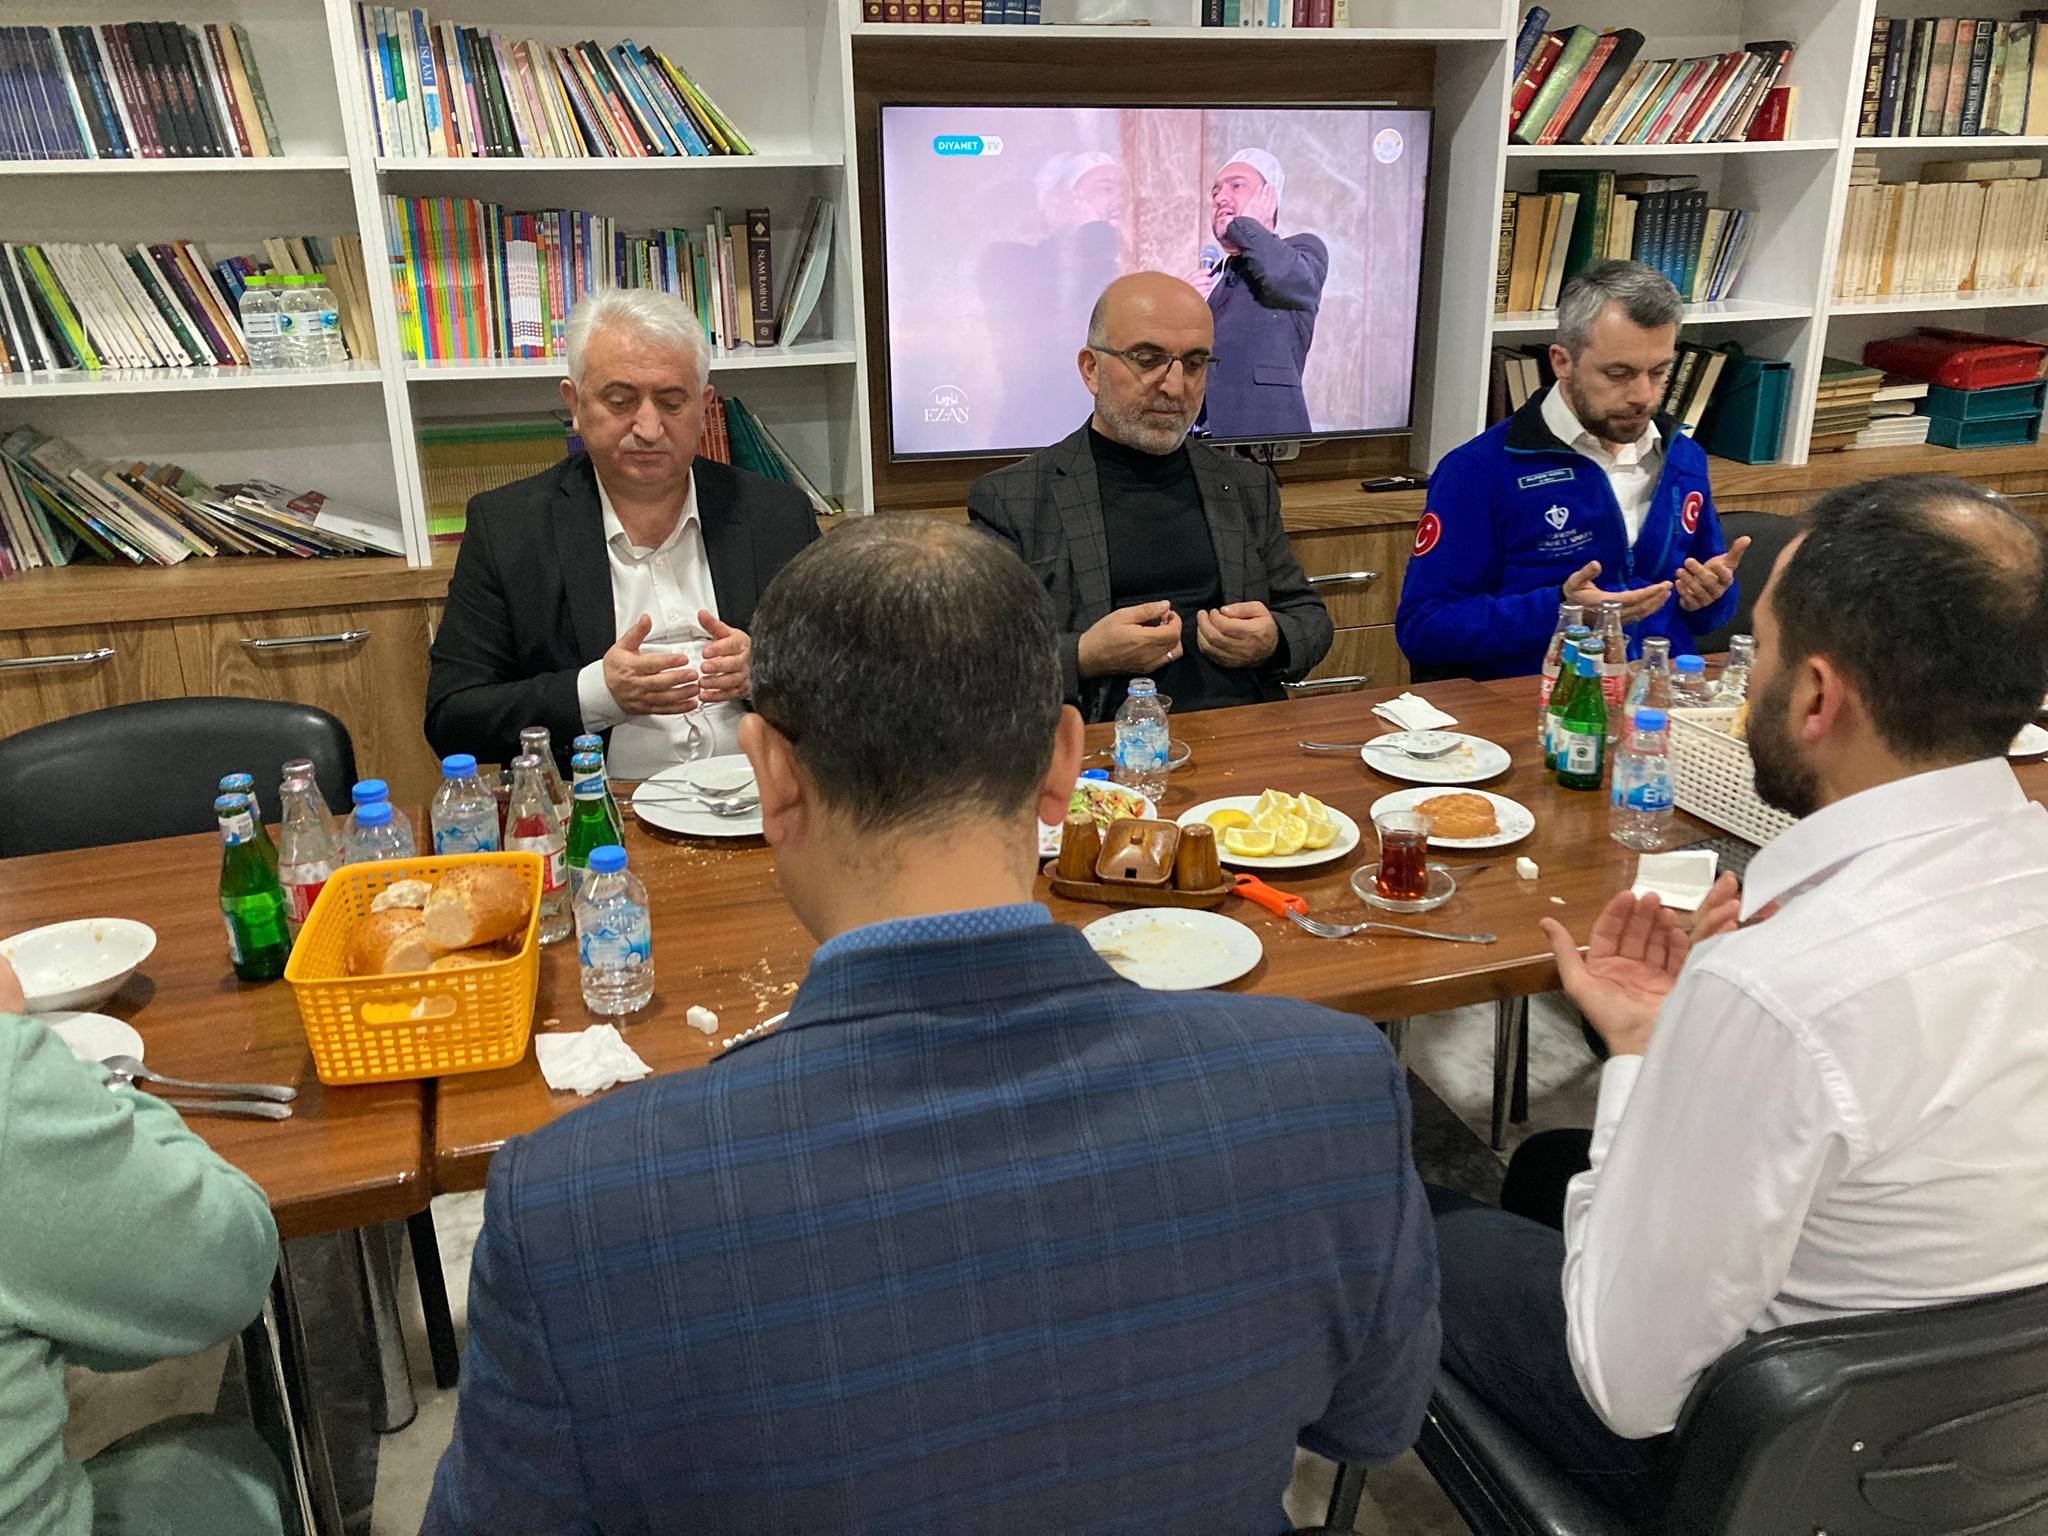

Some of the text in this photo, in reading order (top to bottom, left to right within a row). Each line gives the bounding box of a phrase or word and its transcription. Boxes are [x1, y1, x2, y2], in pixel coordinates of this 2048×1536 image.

[1647, 199, 1652, 209] 1
[1657, 198, 1665, 209] 2
[1672, 199, 1679, 210] 3
[1685, 198, 1692, 207] 4
[1695, 197, 1703, 207] 5
